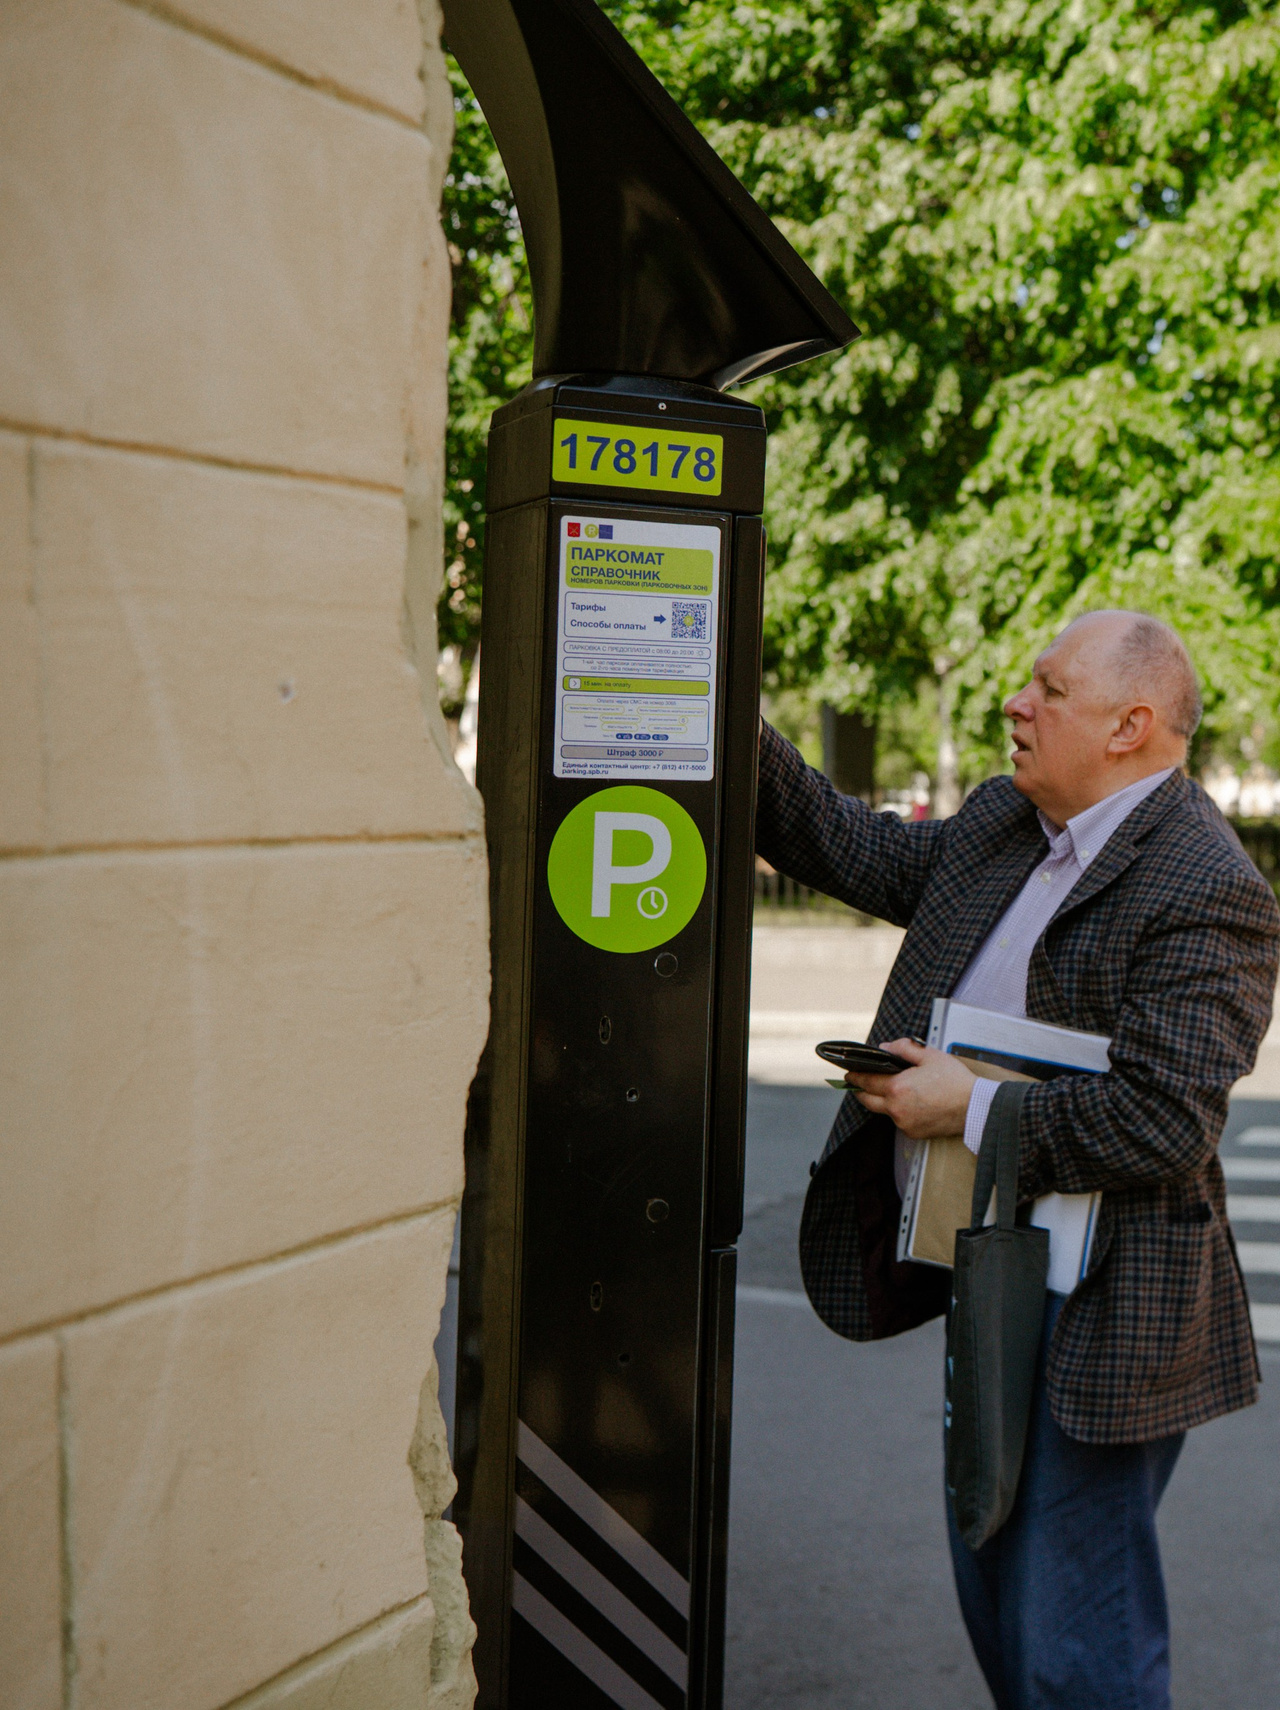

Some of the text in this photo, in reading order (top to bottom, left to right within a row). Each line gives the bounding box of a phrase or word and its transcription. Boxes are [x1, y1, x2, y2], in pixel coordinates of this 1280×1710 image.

[560, 433, 716, 482] 178178
[571, 547, 665, 565] ПАРКОМАТ
[571, 565, 661, 581] СПРАВОЧНИК
[570, 577, 708, 592] НОМЕРОВ ПАРКОВКИ (ПАРКОВОЧНЫХ ЗОН)
[570, 602, 606, 612] Тарифы
[570, 619, 646, 631] Способы оплаты
[607, 646, 651, 654] ПРЕДОПЛАТОЙ
[606, 748, 637, 758] Штраф
[638, 749, 657, 757] 3000
[562, 761, 588, 769] Единый
[562, 768, 609, 776] parking.spb.ru
[591, 810, 672, 918] P
